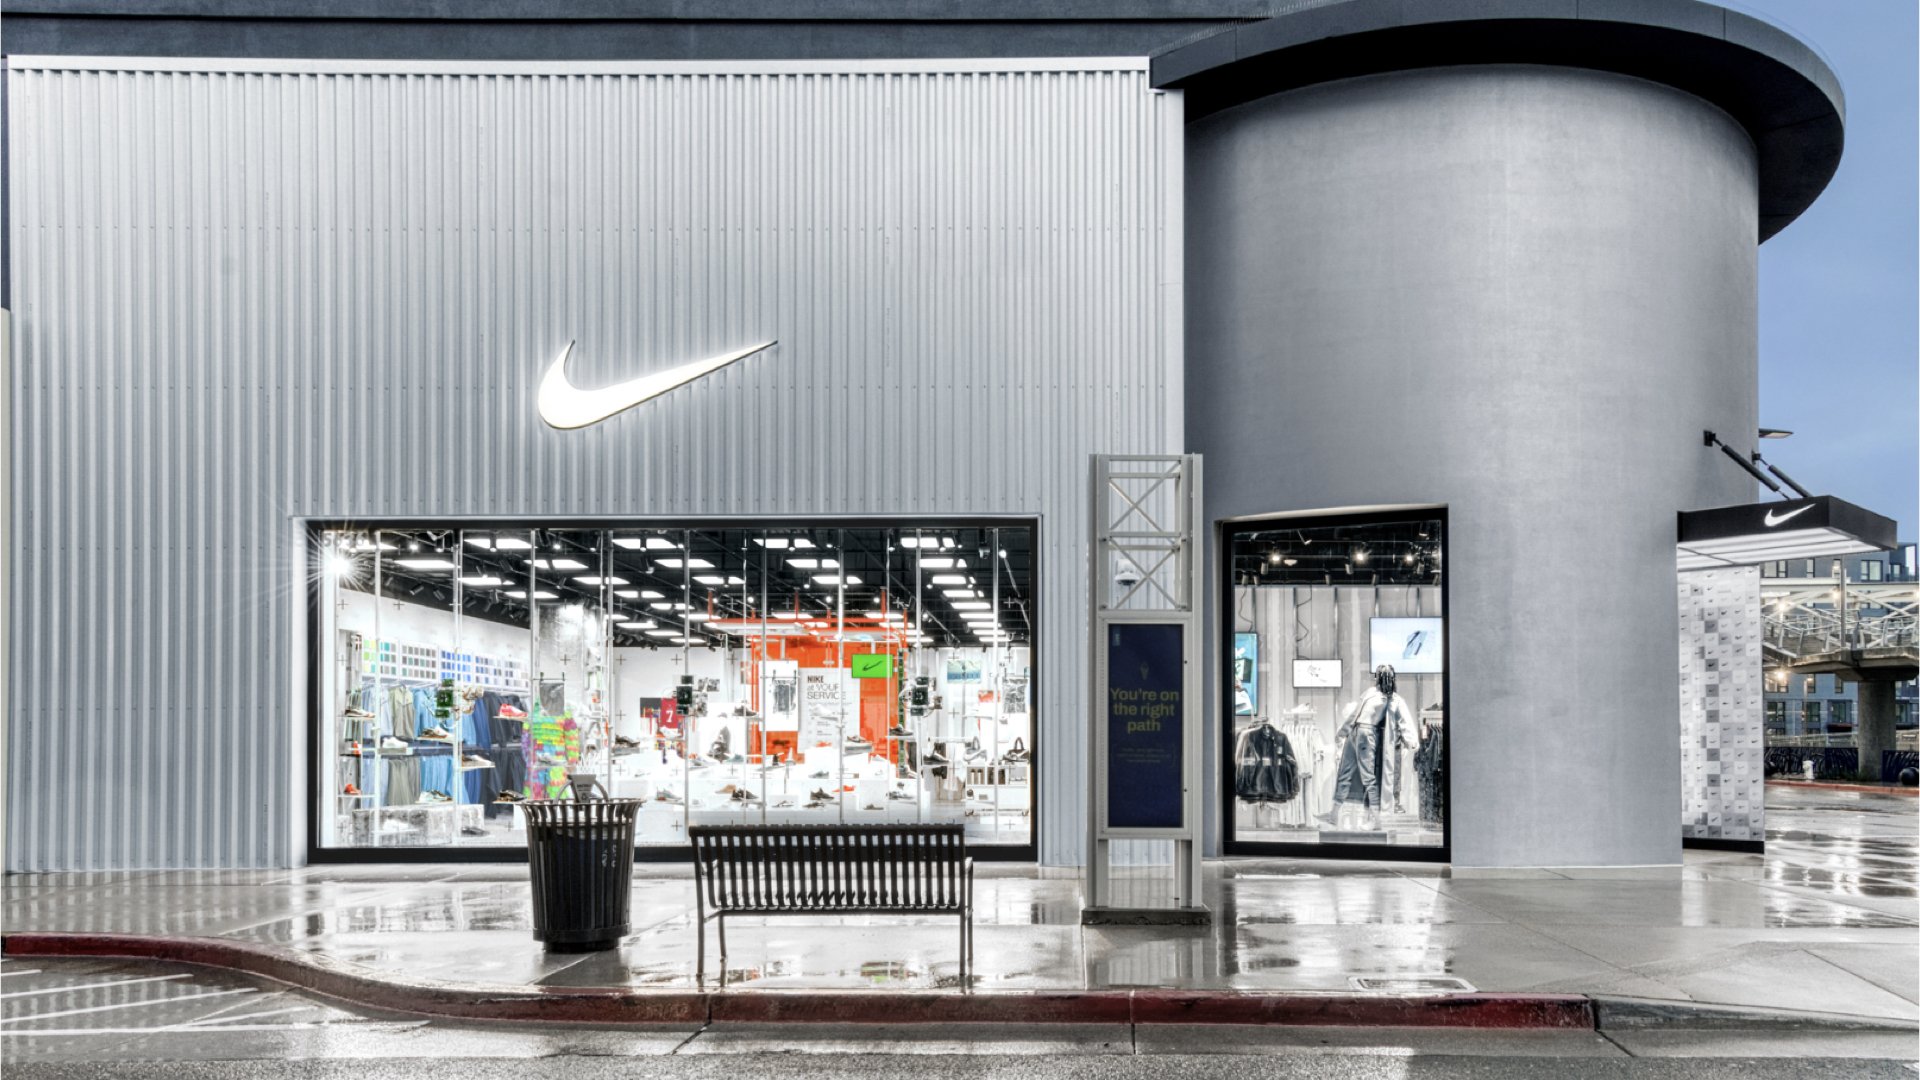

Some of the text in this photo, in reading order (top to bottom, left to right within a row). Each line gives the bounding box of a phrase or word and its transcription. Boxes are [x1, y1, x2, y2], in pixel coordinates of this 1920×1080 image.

[807, 675, 824, 683] NIKE
[1110, 687, 1179, 701] You're on
[666, 710, 673, 723] 7
[1113, 703, 1175, 719] the right
[1127, 719, 1161, 734] path
